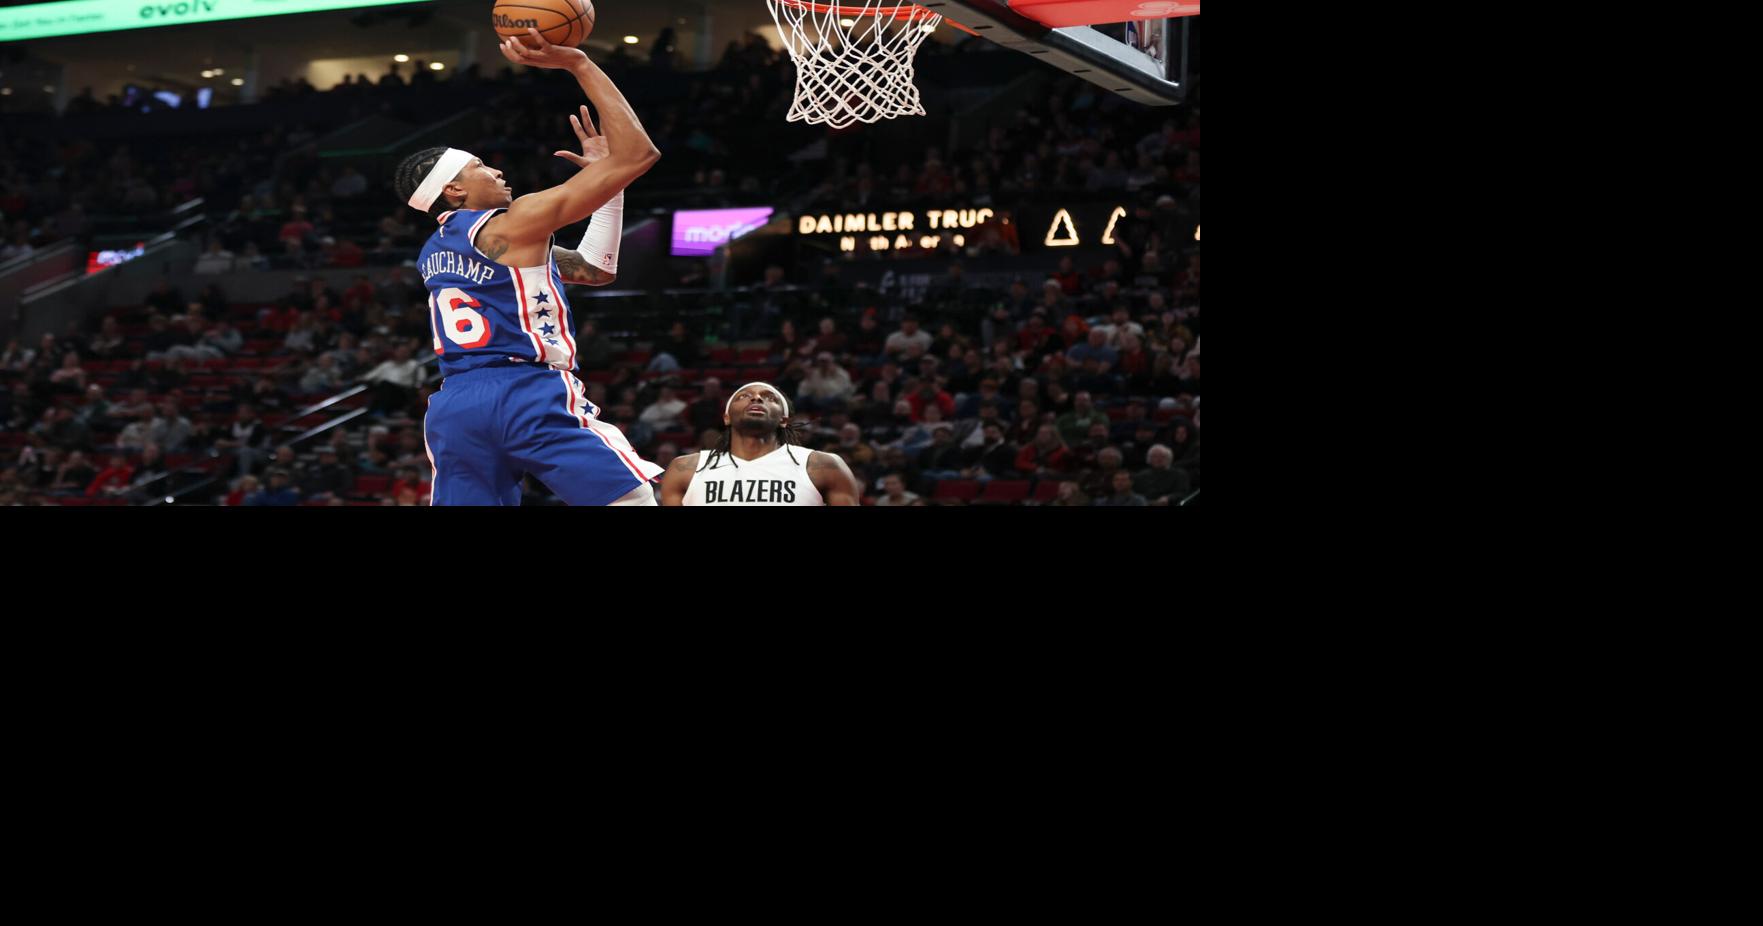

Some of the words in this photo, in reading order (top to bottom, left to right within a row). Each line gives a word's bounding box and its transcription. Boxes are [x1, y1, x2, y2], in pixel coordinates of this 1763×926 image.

[799, 211, 914, 234] DAIMLER
[428, 287, 492, 356] 16
[704, 479, 797, 504] BLAZERS
